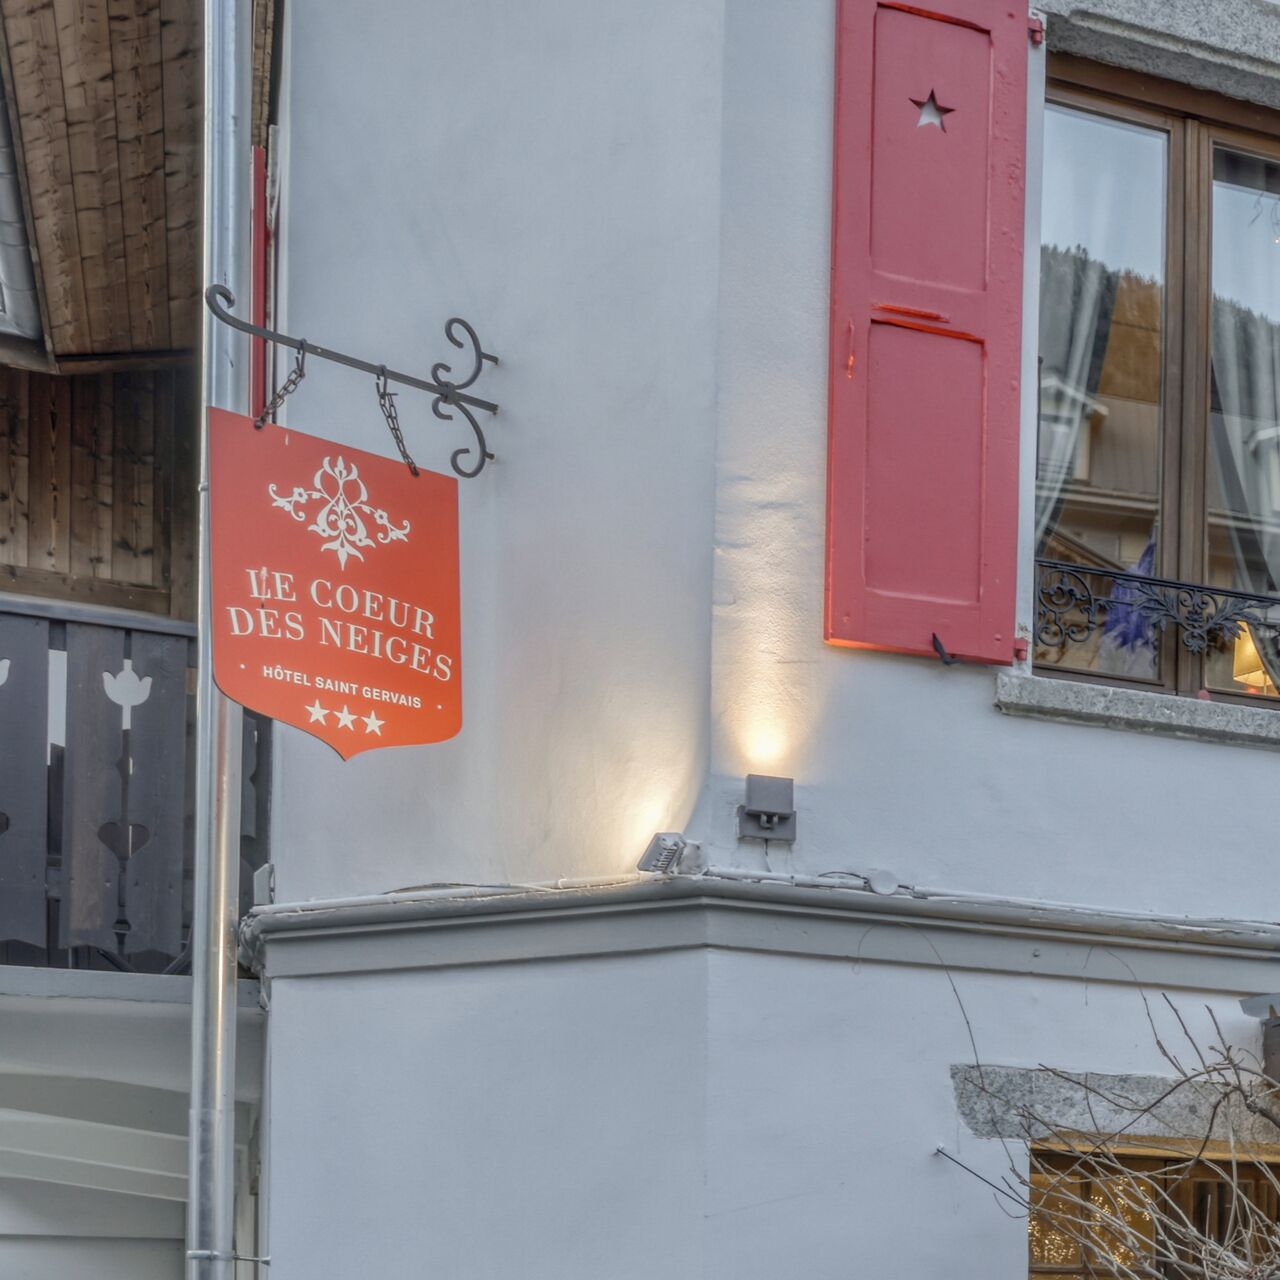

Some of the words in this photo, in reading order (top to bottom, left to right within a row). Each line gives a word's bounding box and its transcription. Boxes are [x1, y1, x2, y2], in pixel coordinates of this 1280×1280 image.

[246, 568, 296, 602] LE
[310, 578, 434, 639] COEUR
[226, 606, 304, 641] DES
[319, 617, 452, 682] NEIGES
[263, 664, 311, 687] HÔTEL
[315, 676, 358, 696] SAINT
[362, 686, 421, 709] GERVAIS
